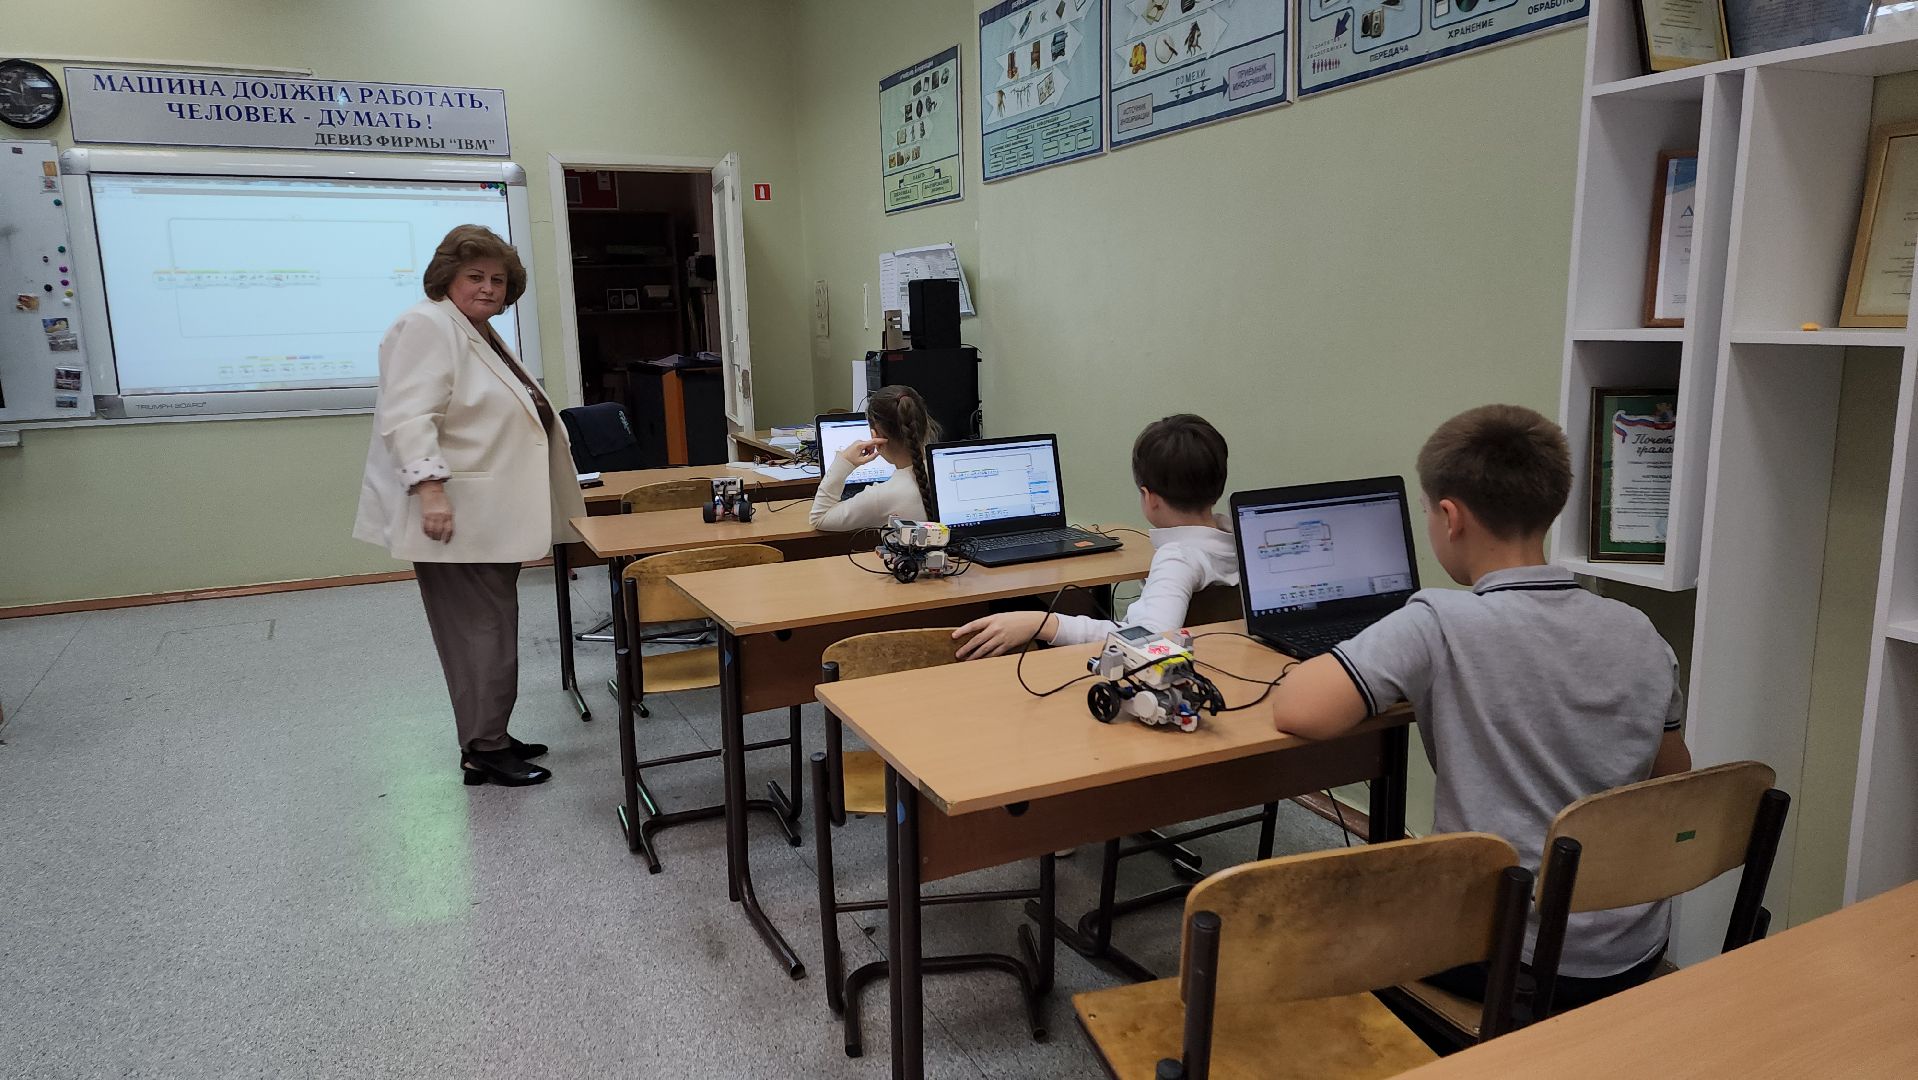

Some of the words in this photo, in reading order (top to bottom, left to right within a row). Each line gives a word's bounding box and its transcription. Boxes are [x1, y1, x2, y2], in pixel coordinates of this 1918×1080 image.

[1447, 17, 1494, 39] ХРАНЕНИЕ
[1369, 43, 1409, 62] ПЕРЕДАЧА
[1175, 68, 1206, 86] ПОМЕХИ
[92, 73, 227, 97] МАШИНА
[232, 80, 353, 103] ДОЛЖНА
[358, 86, 490, 113] РАБОТАТЬ,
[165, 102, 297, 124] ЧЕЛОВЕК
[314, 132, 373, 147] ДЕВИЗ
[376, 134, 445, 149] ФИРМЫ
[1631, 433, 1675, 445] Почет
[1636, 446, 1674, 457] грамо
